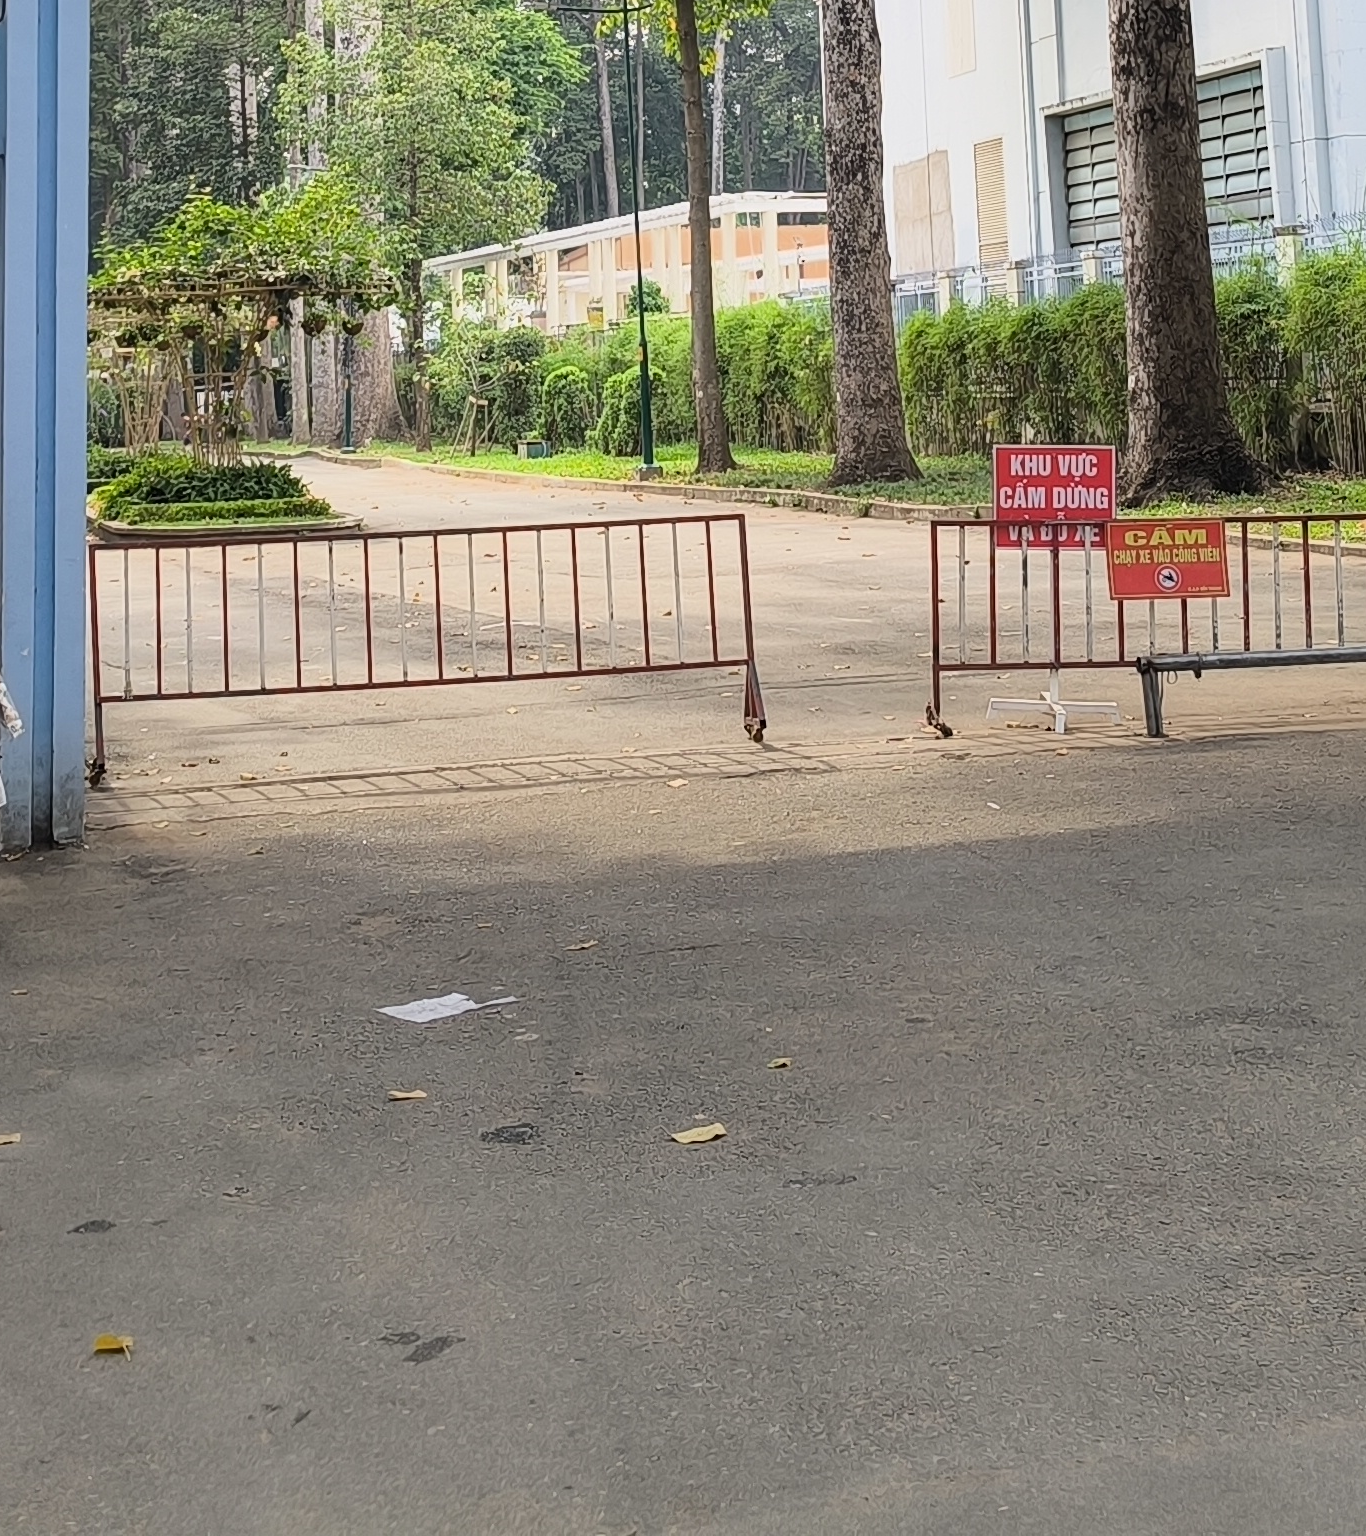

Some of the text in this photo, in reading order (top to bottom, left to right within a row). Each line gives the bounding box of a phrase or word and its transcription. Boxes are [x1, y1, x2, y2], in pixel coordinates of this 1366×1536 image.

[1010, 452, 1098, 481] KHU VỰC
[999, 478, 1109, 509] CẤM DỪNG
[1124, 524, 1207, 546] CẤM
[1113, 545, 1221, 567] CHẠY XE VÀO CÔNG VIÊN
